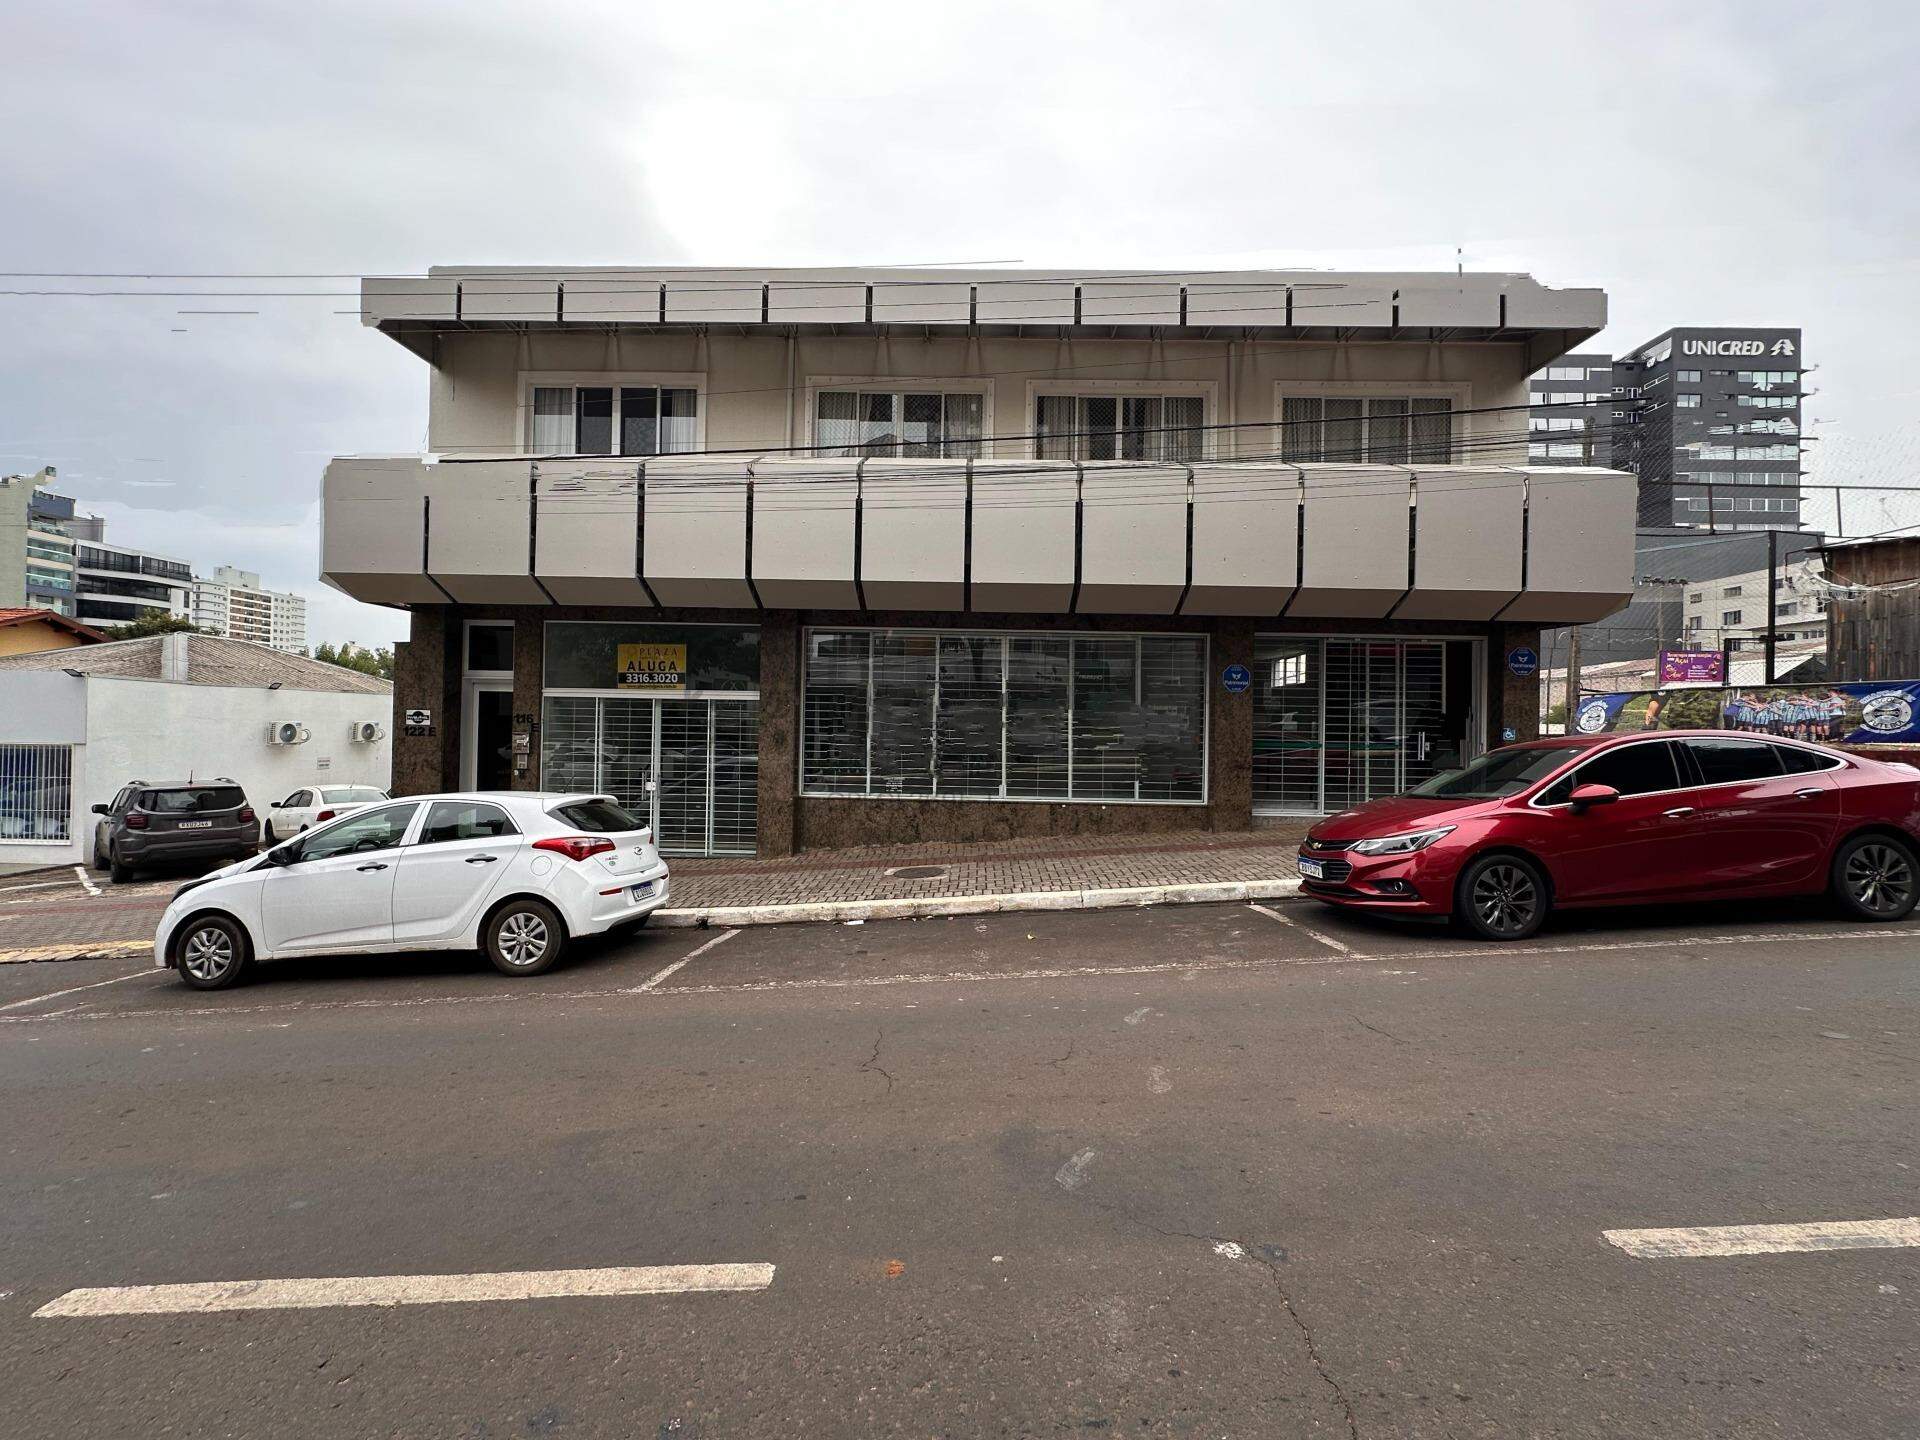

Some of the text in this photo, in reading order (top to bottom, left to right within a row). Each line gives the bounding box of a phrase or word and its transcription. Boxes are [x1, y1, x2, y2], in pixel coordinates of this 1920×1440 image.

[1682, 339, 1765, 356] UNICRED
[639, 647, 678, 657] PLAZA
[627, 661, 678, 672] ALUGA
[626, 673, 679, 683] 3316.3020
[403, 726, 437, 737] 122 E
